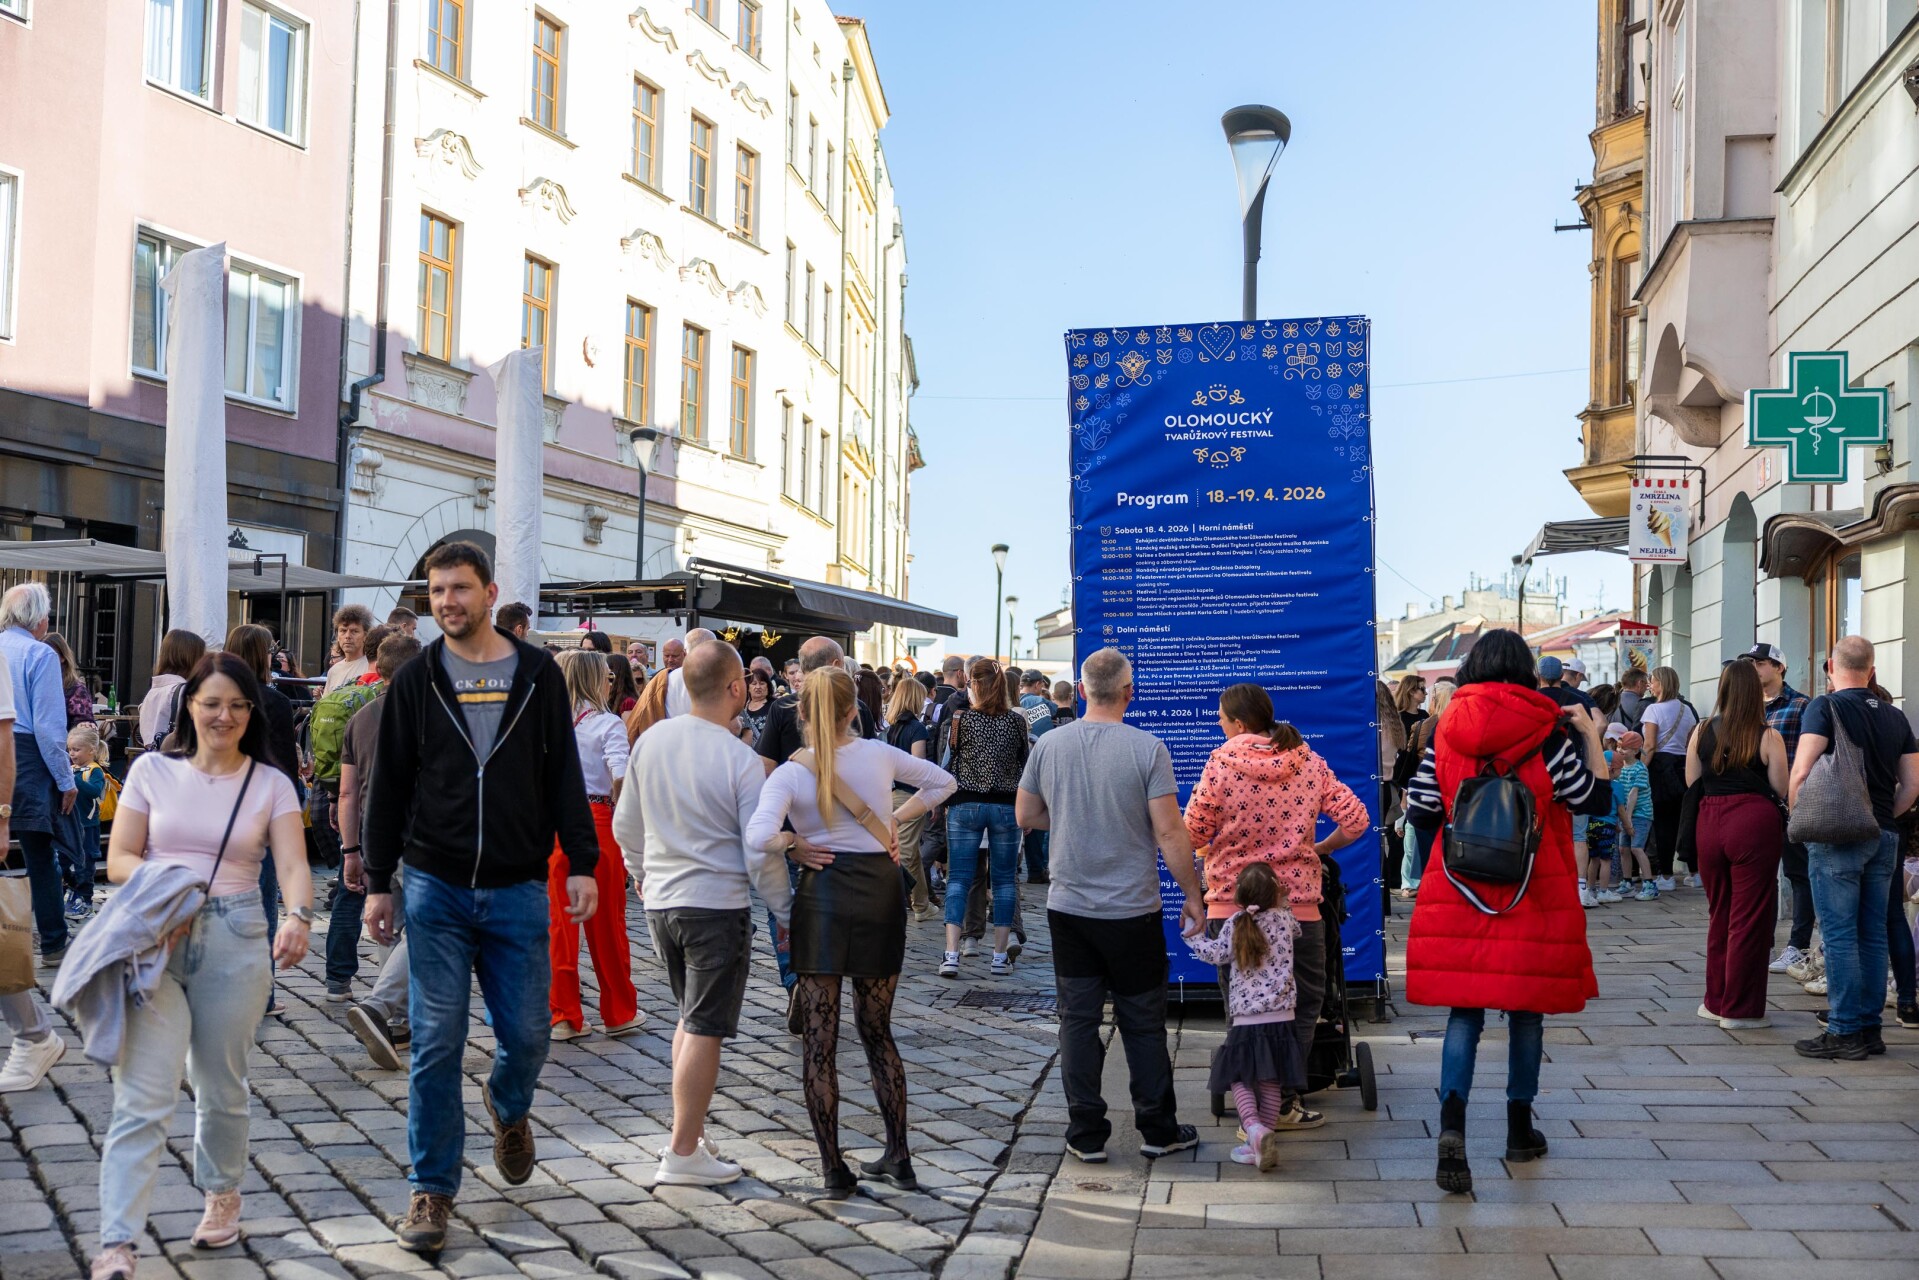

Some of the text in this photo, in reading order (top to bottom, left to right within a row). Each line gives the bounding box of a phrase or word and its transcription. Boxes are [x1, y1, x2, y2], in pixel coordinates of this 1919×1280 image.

[1164, 408, 1273, 428] OLOMOUCKÝ
[1165, 428, 1273, 441] TVARŮŽKOVÝ FESTIVAL
[1117, 492, 1188, 509] Program
[1264, 488, 1279, 500] 4.
[1283, 487, 1325, 500] 2026
[1199, 523, 1220, 531] Horní
[1222, 522, 1254, 530] náměstí
[1259, 547, 1274, 556] Český
[1027, 704, 1048, 716] ROYAL
